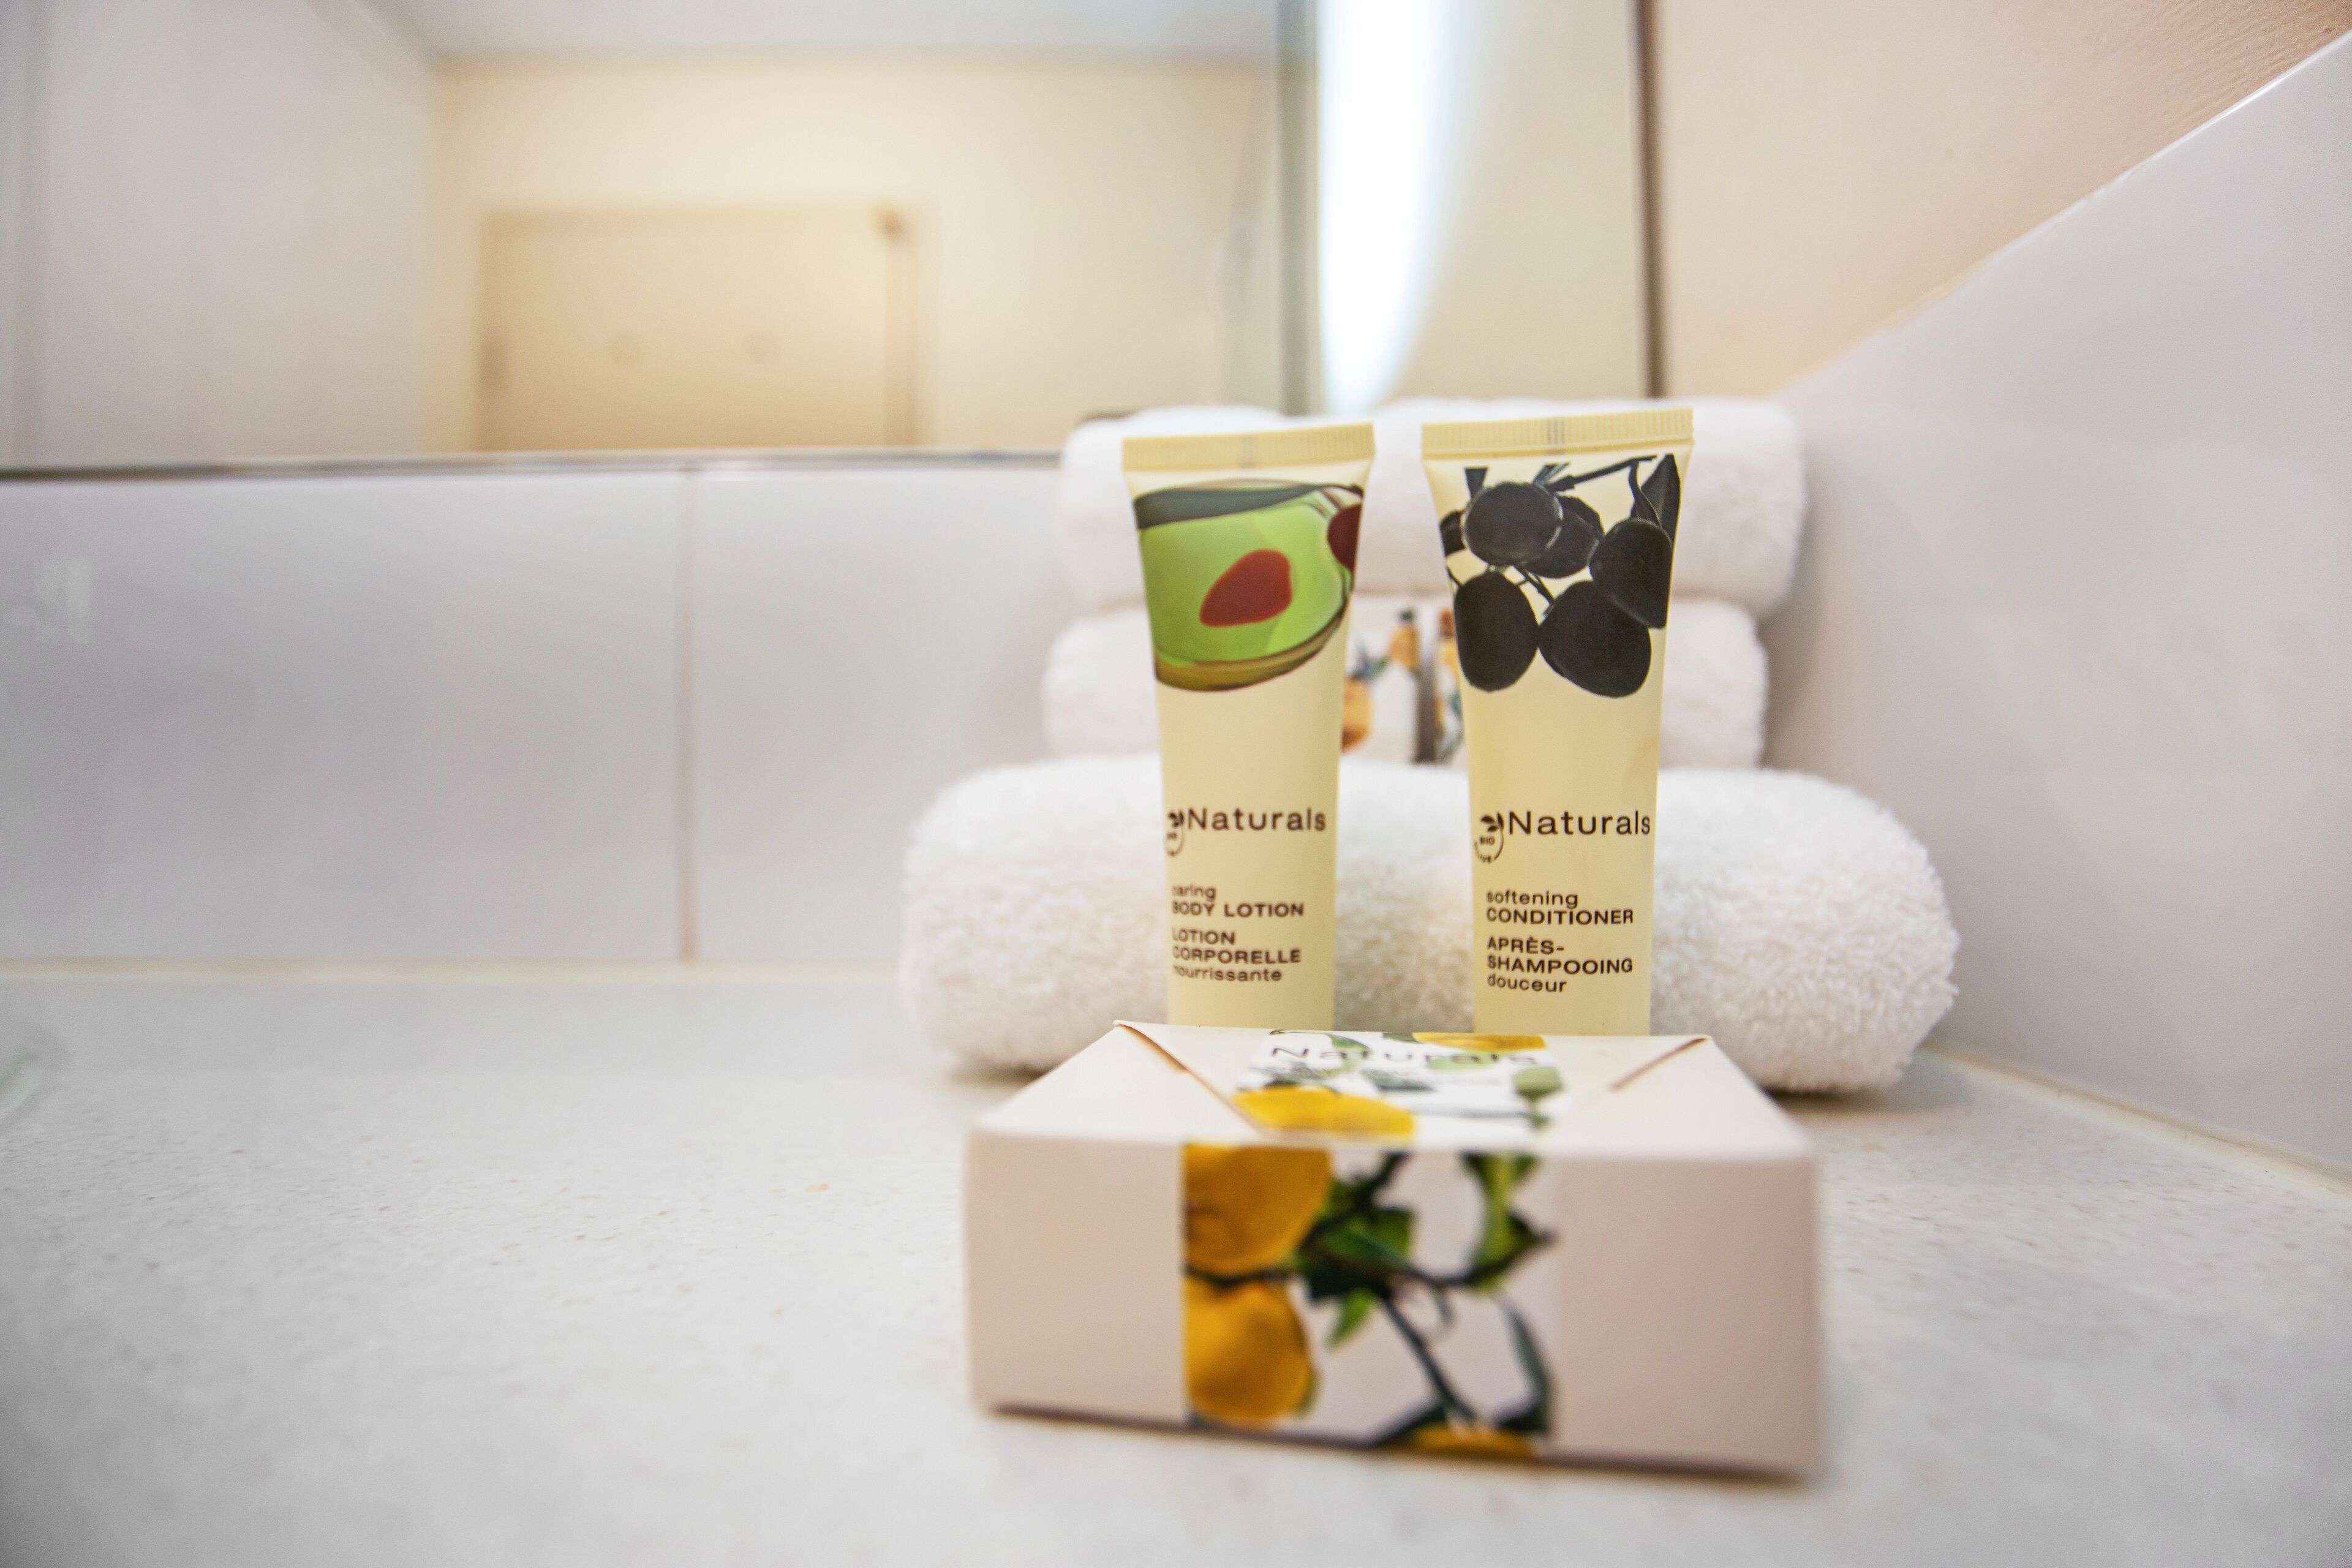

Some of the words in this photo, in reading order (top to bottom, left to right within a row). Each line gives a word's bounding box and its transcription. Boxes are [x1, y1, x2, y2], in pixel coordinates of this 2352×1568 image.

[1187, 806, 1327, 831] Naturals
[1508, 810, 1651, 836] Naturals
[1486, 889, 1578, 909] softening
[1172, 901, 1215, 916] BODY
[1223, 902, 1305, 918] LOTION
[1486, 907, 1634, 925] CONDITIONER
[1172, 926, 1236, 945] LOTION
[1487, 935, 1565, 955] APRÈS-
[1172, 946, 1302, 965] CORPORELLE
[1487, 954, 1633, 975] SHAMPOOING
[1487, 973, 1567, 993] douceur
